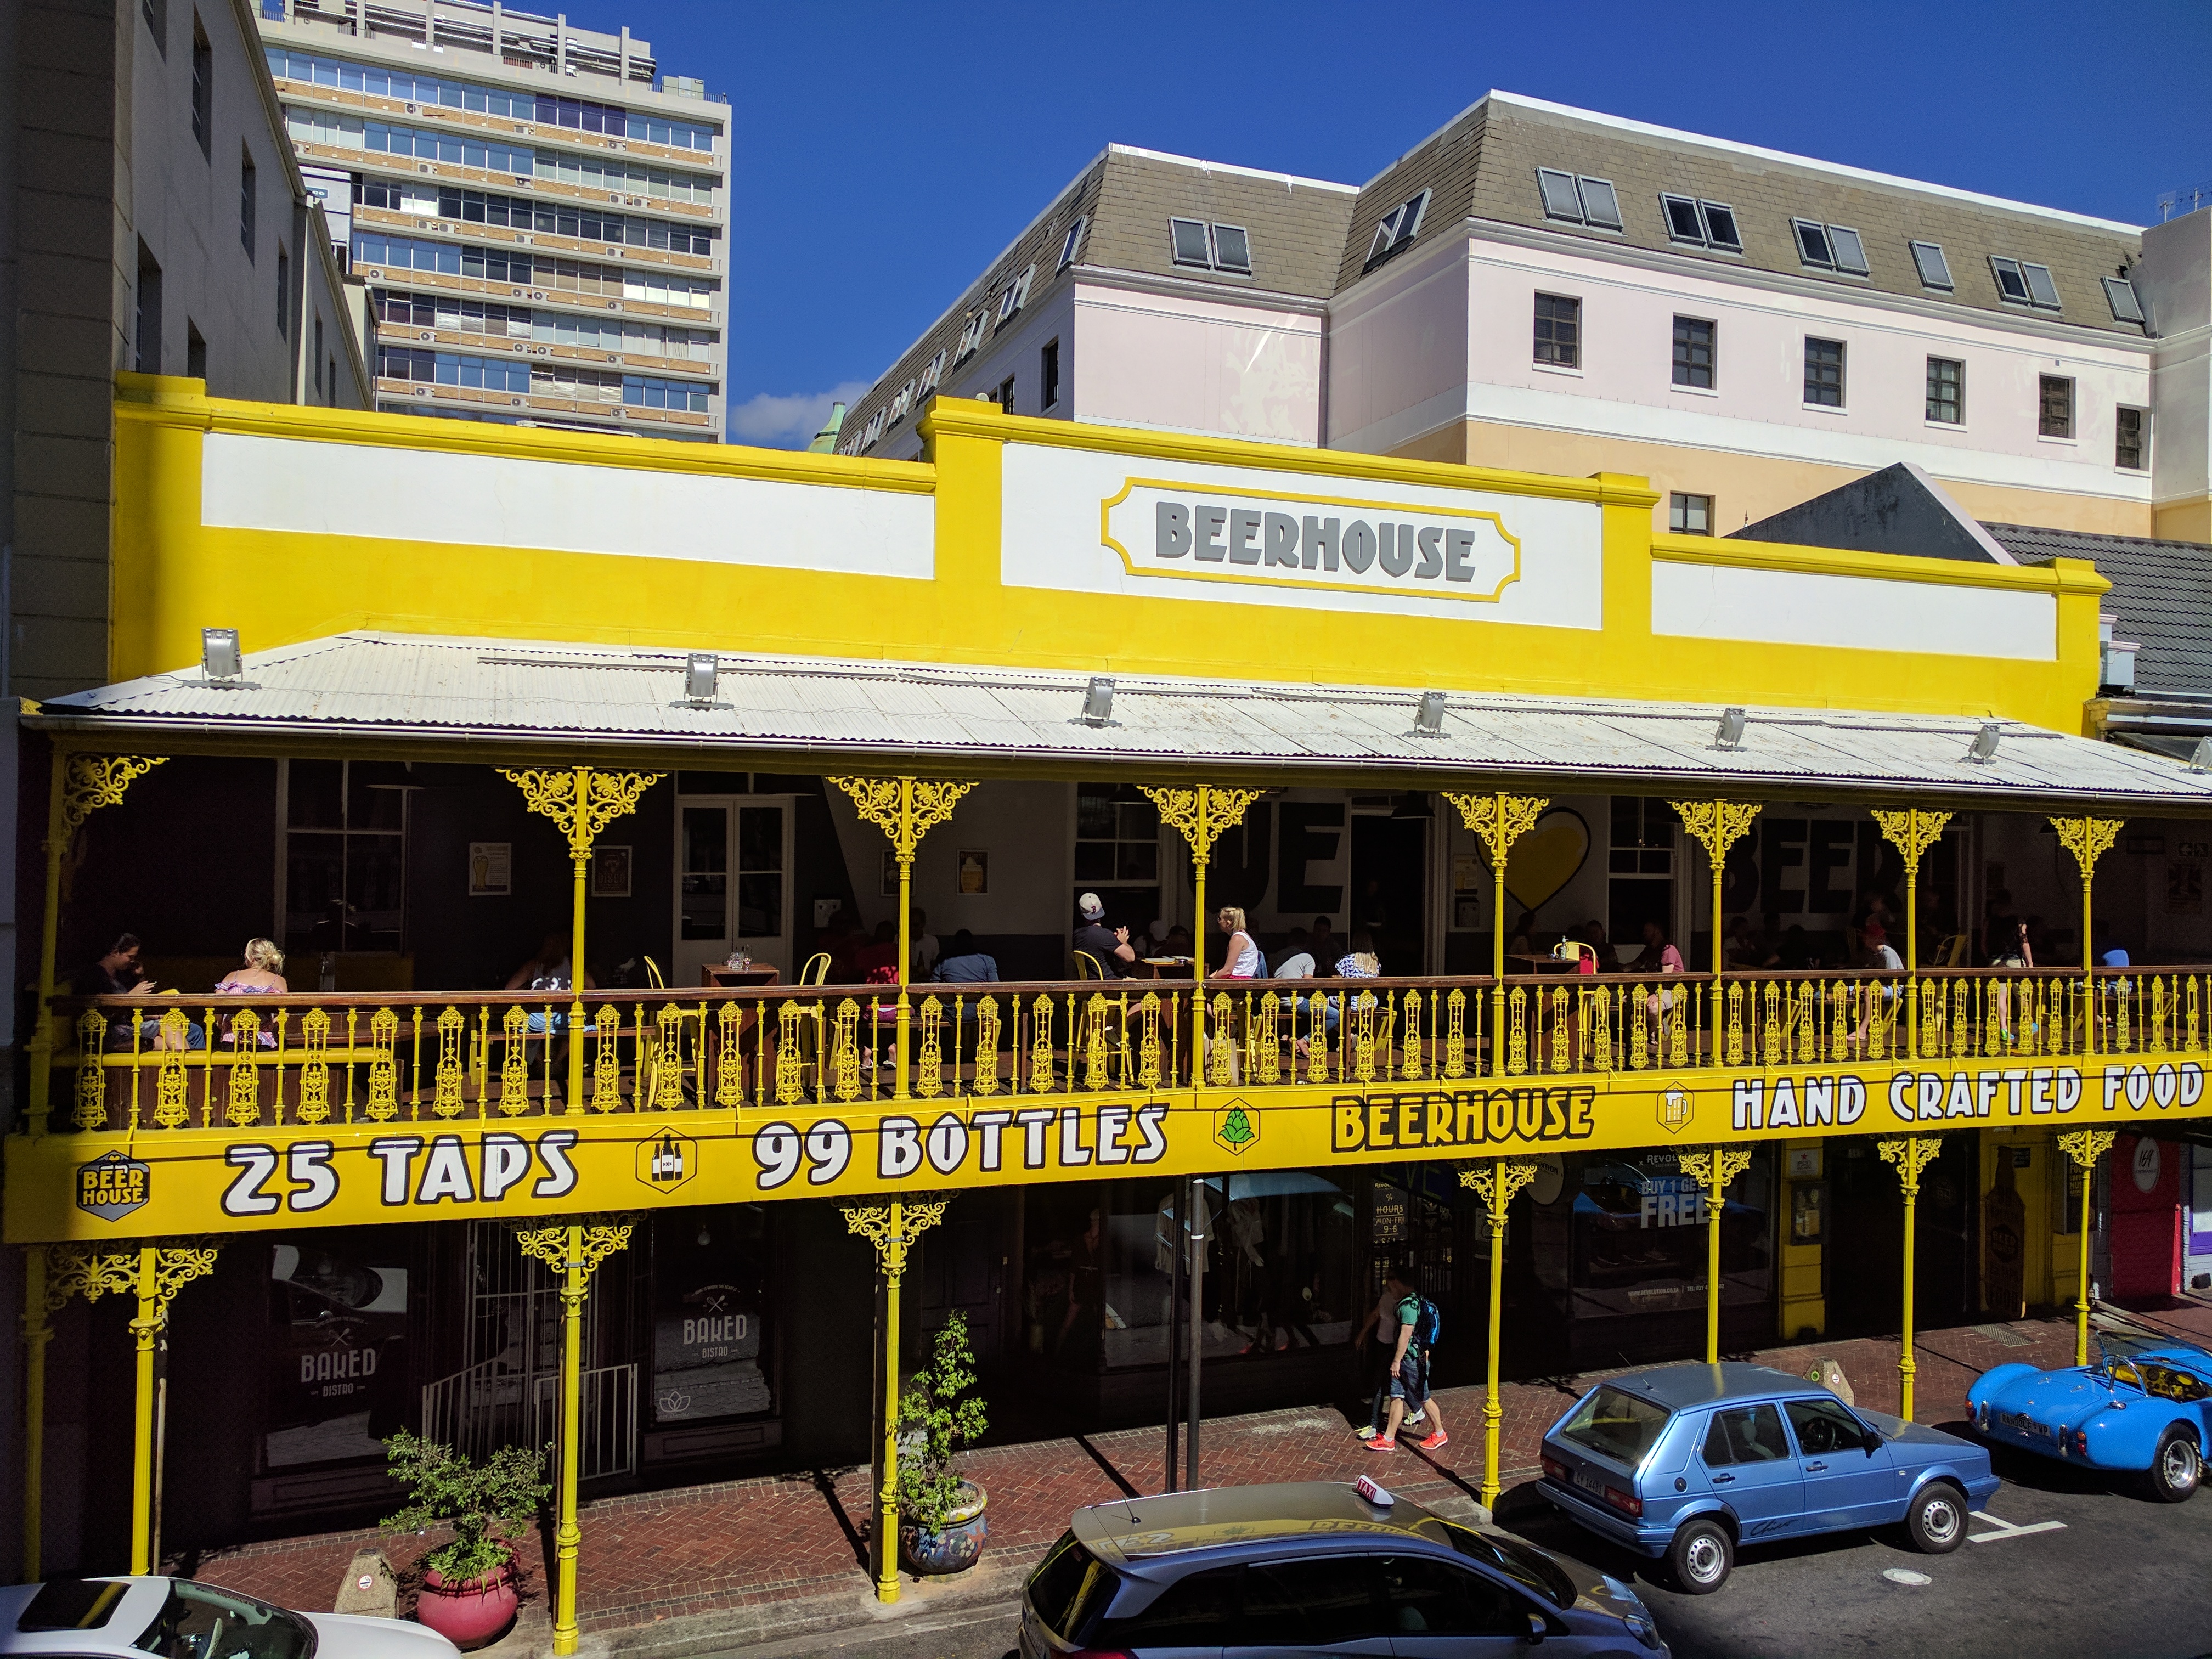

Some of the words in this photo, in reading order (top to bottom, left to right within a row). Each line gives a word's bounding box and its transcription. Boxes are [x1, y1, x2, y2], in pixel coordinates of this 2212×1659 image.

[1155, 501, 1476, 583] BEERHOUSE
[1732, 1074, 1867, 1131] HAND
[1888, 1066, 2083, 1122] CRAFTED
[2102, 1062, 2205, 1112] FOOD
[1331, 1085, 1595, 1153] BEERHOUSE
[752, 1118, 853, 1191] 99
[877, 1102, 1170, 1180] BOTTLES
[83, 1169, 144, 1189] BEER
[220, 1139, 340, 1217] 25
[367, 1128, 579, 1206] TAPS
[83, 1188, 143, 1205] HOUSE
[1641, 1180, 1666, 1195] BUY
[1671, 1179, 1675, 1193] 1
[1376, 1204, 1403, 1214] HOURS
[1640, 1192, 1709, 1229] FREE
[1374, 1216, 1404, 1226] MON-FRI
[1383, 1224, 1397, 1233] 9-6
[684, 1314, 747, 1345] BAKED
[702, 1346, 728, 1358] BISTRO
[301, 1348, 376, 1383] BAKED
[323, 1383, 354, 1397] BISTRO
[1358, 1479, 1376, 1499] TAXI
